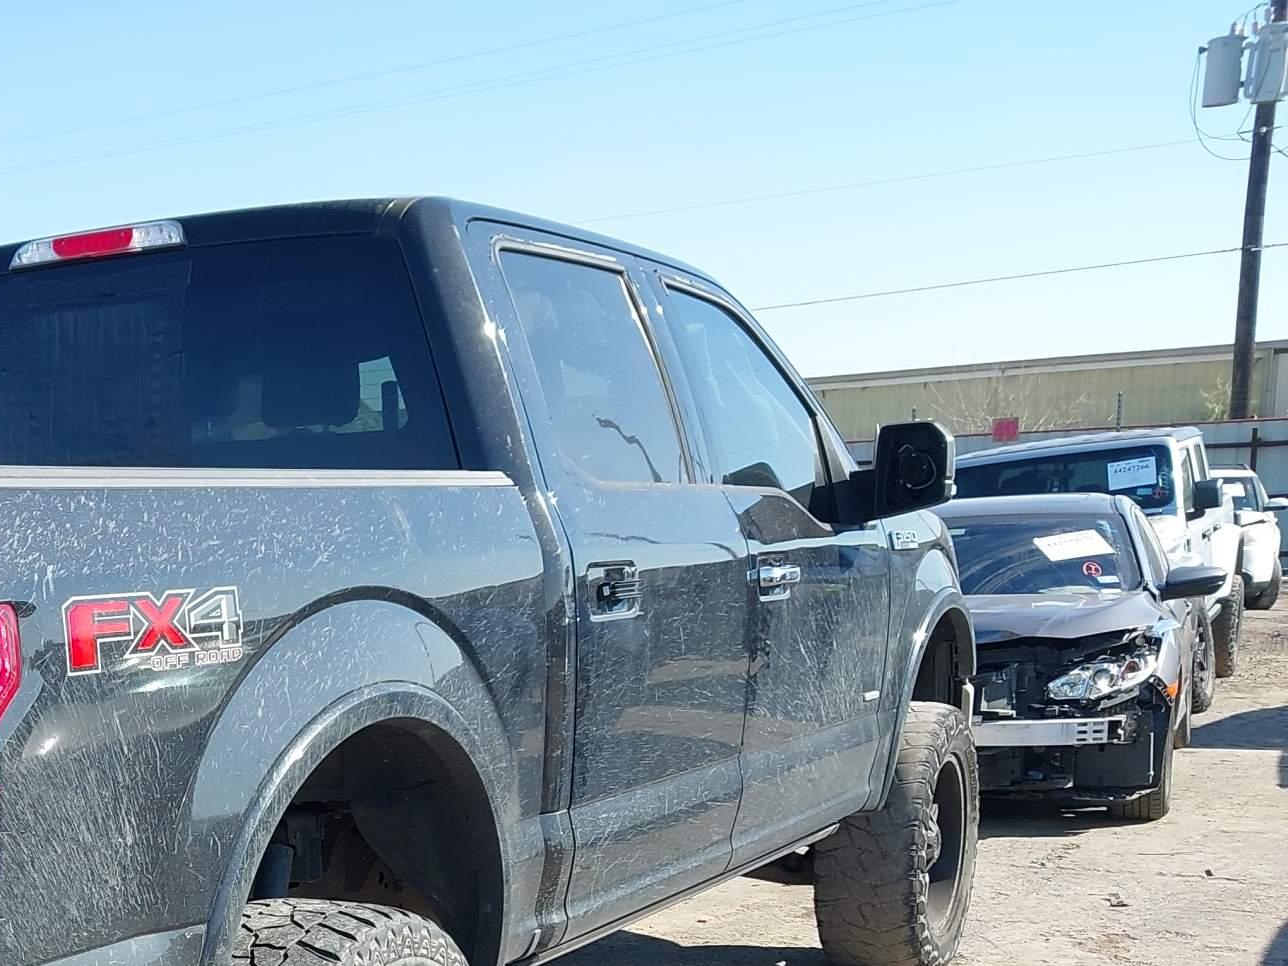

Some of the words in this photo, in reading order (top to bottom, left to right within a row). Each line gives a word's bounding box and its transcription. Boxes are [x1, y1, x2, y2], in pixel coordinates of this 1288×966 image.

[62, 586, 243, 675] FX4
[150, 654, 189, 671] OFF
[194, 647, 243, 665] ROAD
